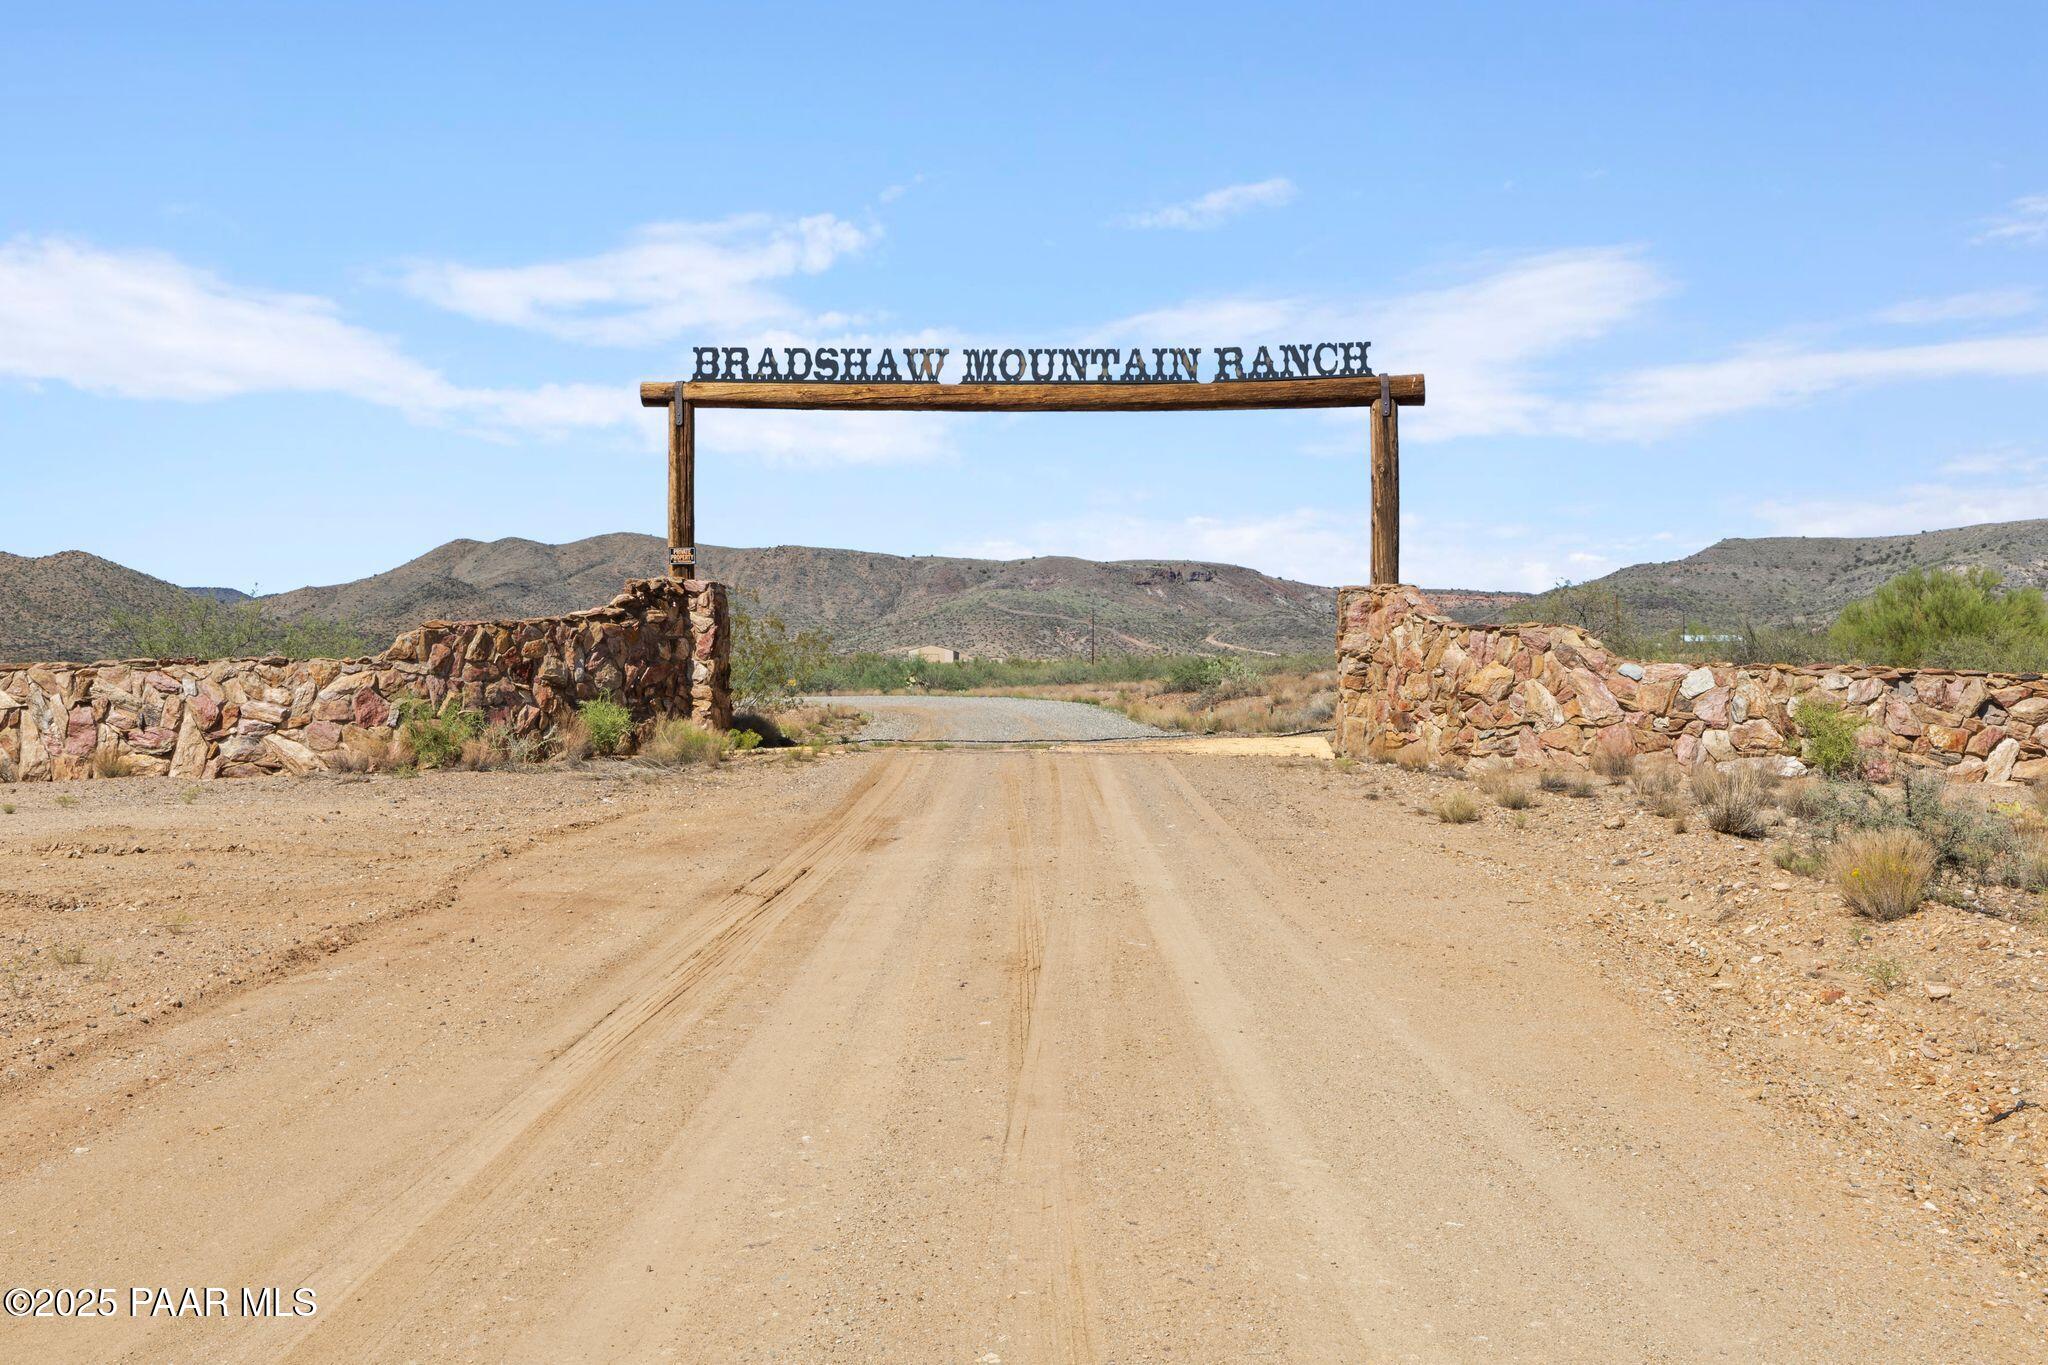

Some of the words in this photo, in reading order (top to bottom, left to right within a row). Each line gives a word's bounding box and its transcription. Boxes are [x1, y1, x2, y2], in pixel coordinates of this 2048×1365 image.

[692, 346, 949, 382] BRADSHAW
[963, 347, 1202, 383] MOUNTAIN
[1213, 341, 1372, 381] RANCH
